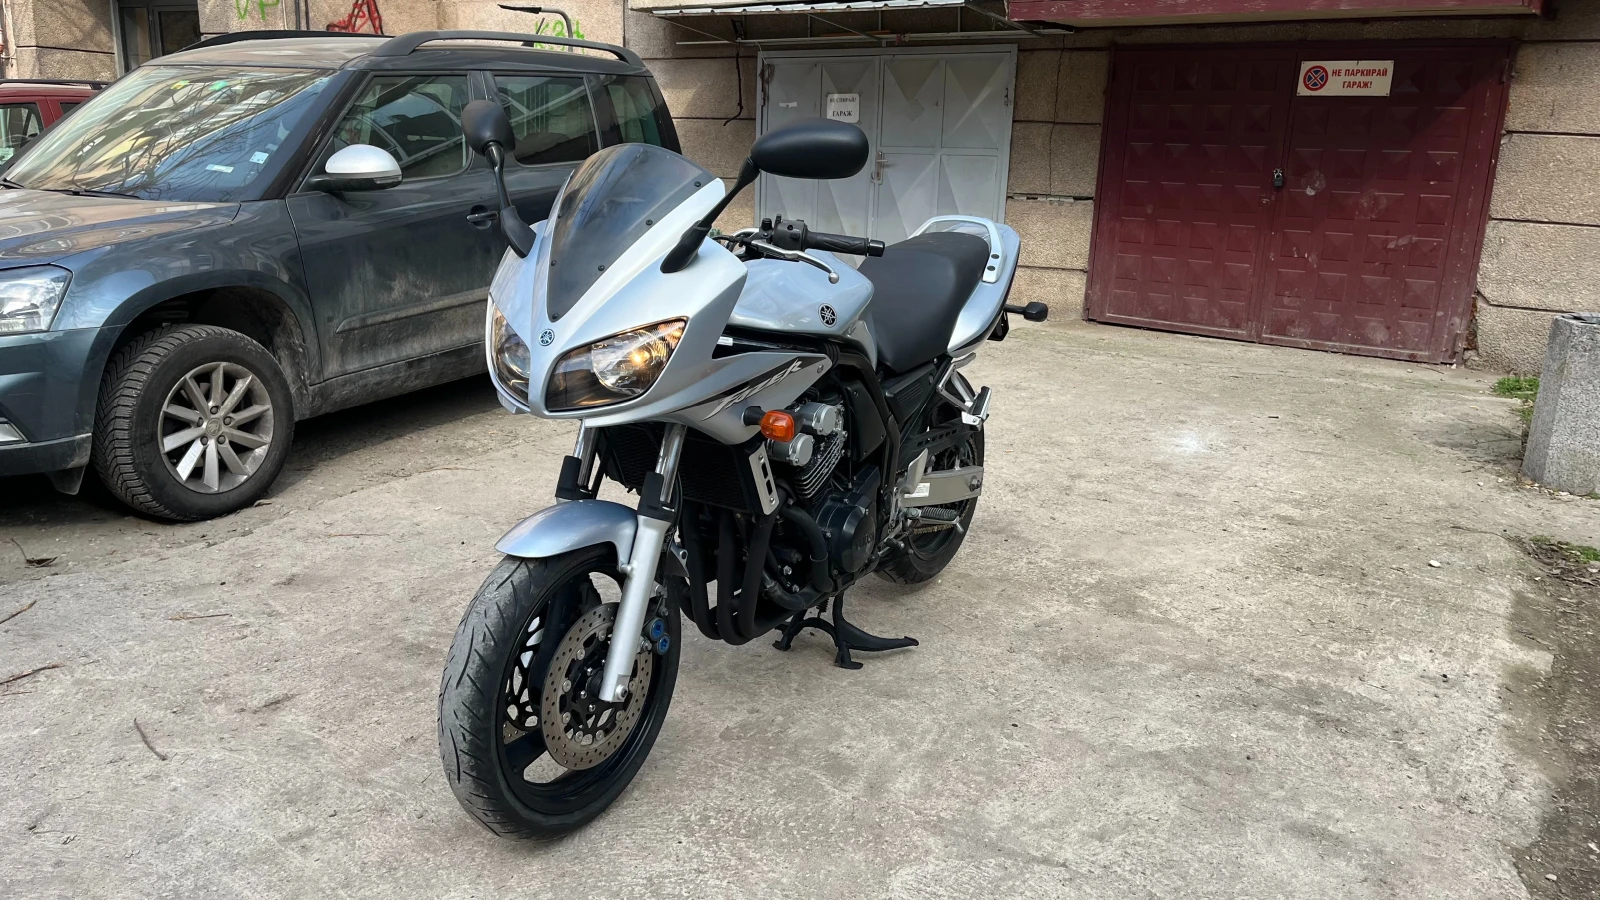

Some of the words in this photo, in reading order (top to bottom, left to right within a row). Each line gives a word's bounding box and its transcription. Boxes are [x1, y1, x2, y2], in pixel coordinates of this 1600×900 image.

[1331, 68, 1342, 77] НЕ
[1344, 67, 1388, 77] ПАРКИРАЙ
[1342, 81, 1373, 89] ГАРАЖ!
